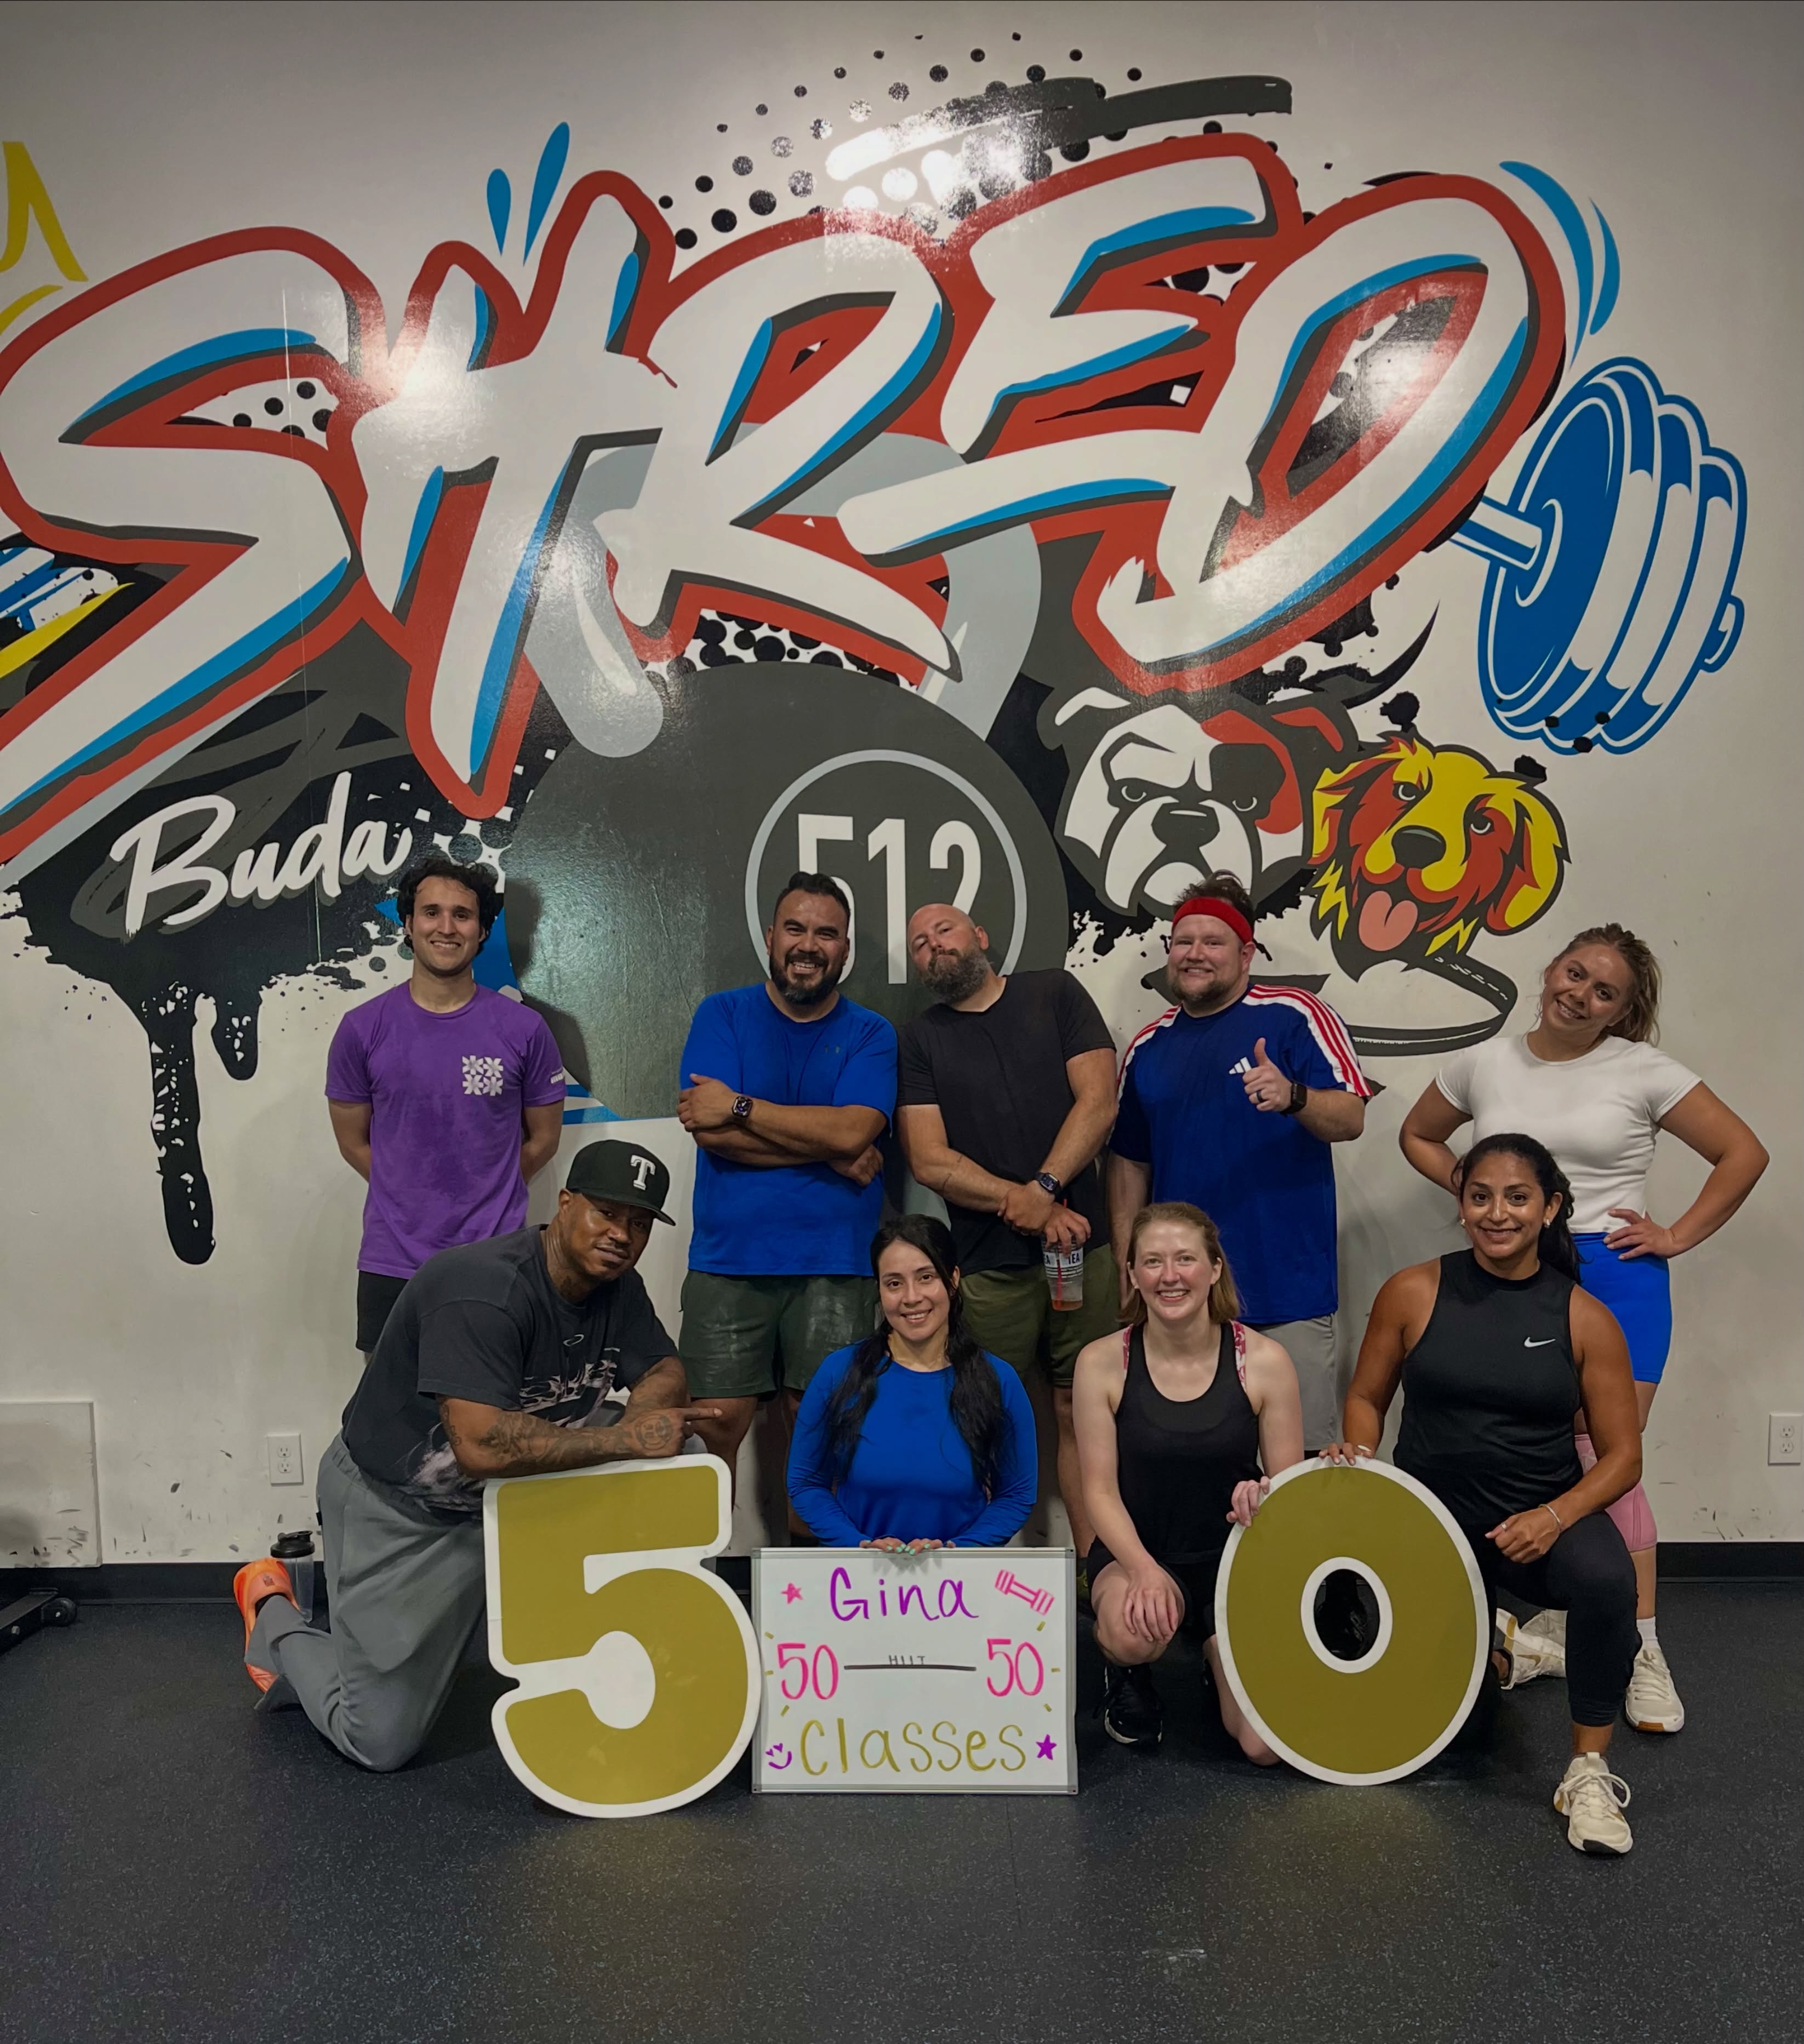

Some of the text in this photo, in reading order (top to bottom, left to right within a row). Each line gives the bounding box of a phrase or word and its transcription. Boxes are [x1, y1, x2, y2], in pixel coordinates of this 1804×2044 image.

[110, 771, 413, 937] Buda
[631, 1155, 656, 1191] T
[829, 1566, 979, 1622] Gina
[483, 1453, 762, 1818] 5
[777, 1637, 1044, 1700] 50 HIIT 50
